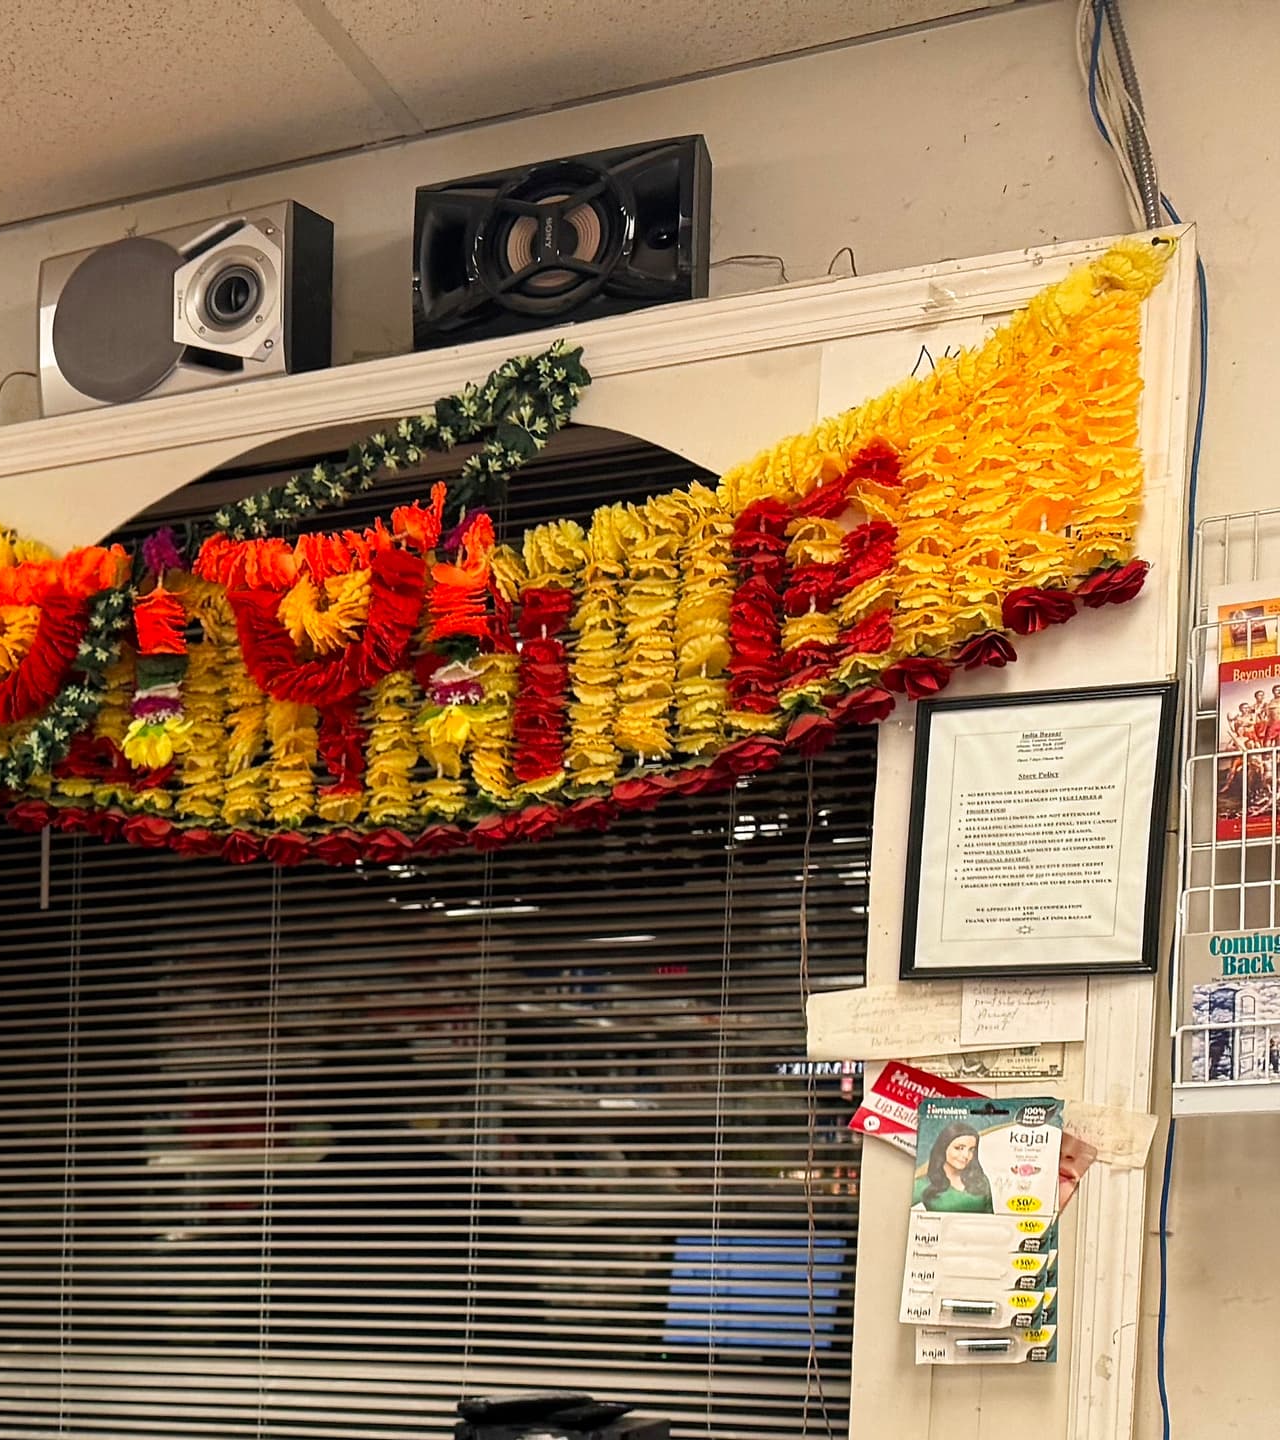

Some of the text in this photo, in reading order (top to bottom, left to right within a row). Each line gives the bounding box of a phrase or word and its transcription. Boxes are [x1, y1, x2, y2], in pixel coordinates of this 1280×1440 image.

[1233, 665, 1271, 683] Beyond
[1038, 771, 1059, 779] Policy
[1222, 953, 1275, 975] Back
[927, 1104, 969, 1115] Himalaya
[1023, 1106, 1046, 1116] 100%
[1009, 1130, 1049, 1146] kajal
